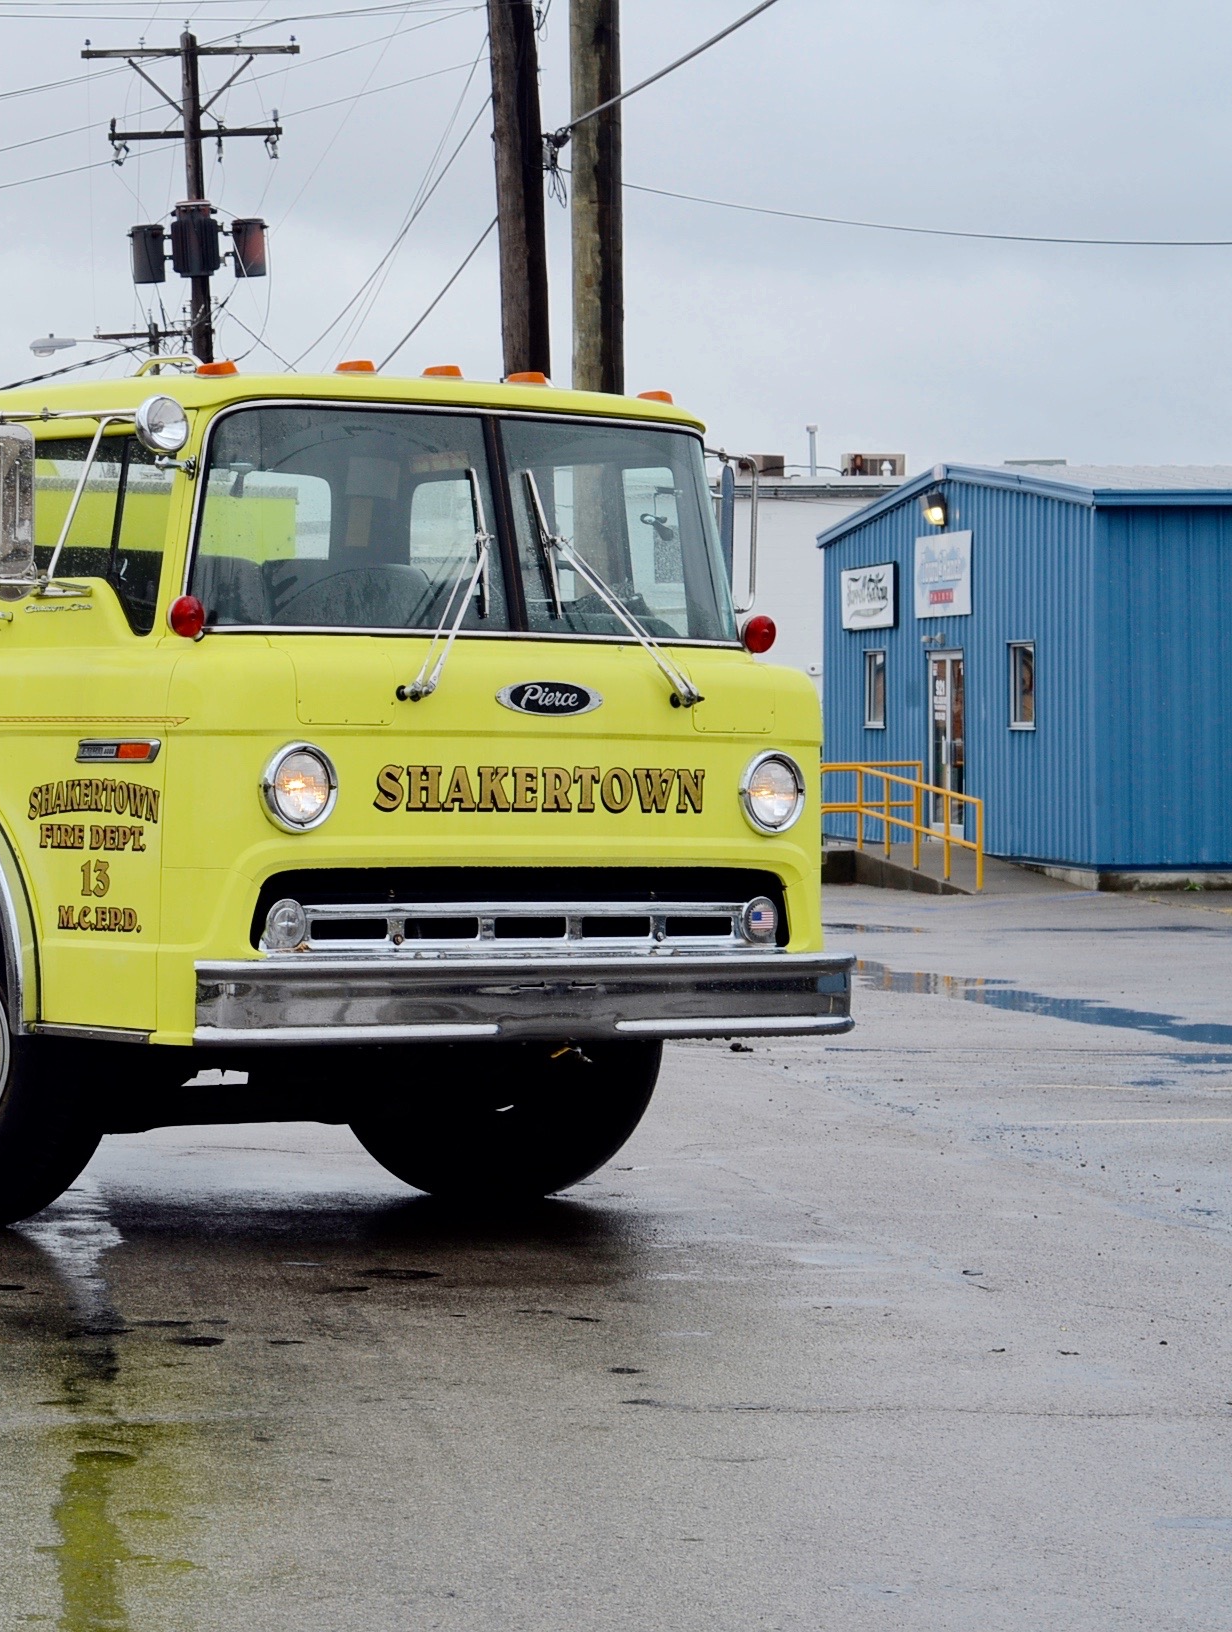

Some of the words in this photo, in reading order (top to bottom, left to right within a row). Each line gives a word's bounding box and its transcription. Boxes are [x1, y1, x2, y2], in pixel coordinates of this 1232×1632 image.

[520, 684, 579, 709] Pierce
[28, 778, 161, 824] SHAKERTOWN
[373, 764, 706, 814] SHAKERTOWN
[39, 823, 85, 850] FIRE
[89, 825, 147, 852] DEPT.
[81, 859, 111, 898] 13
